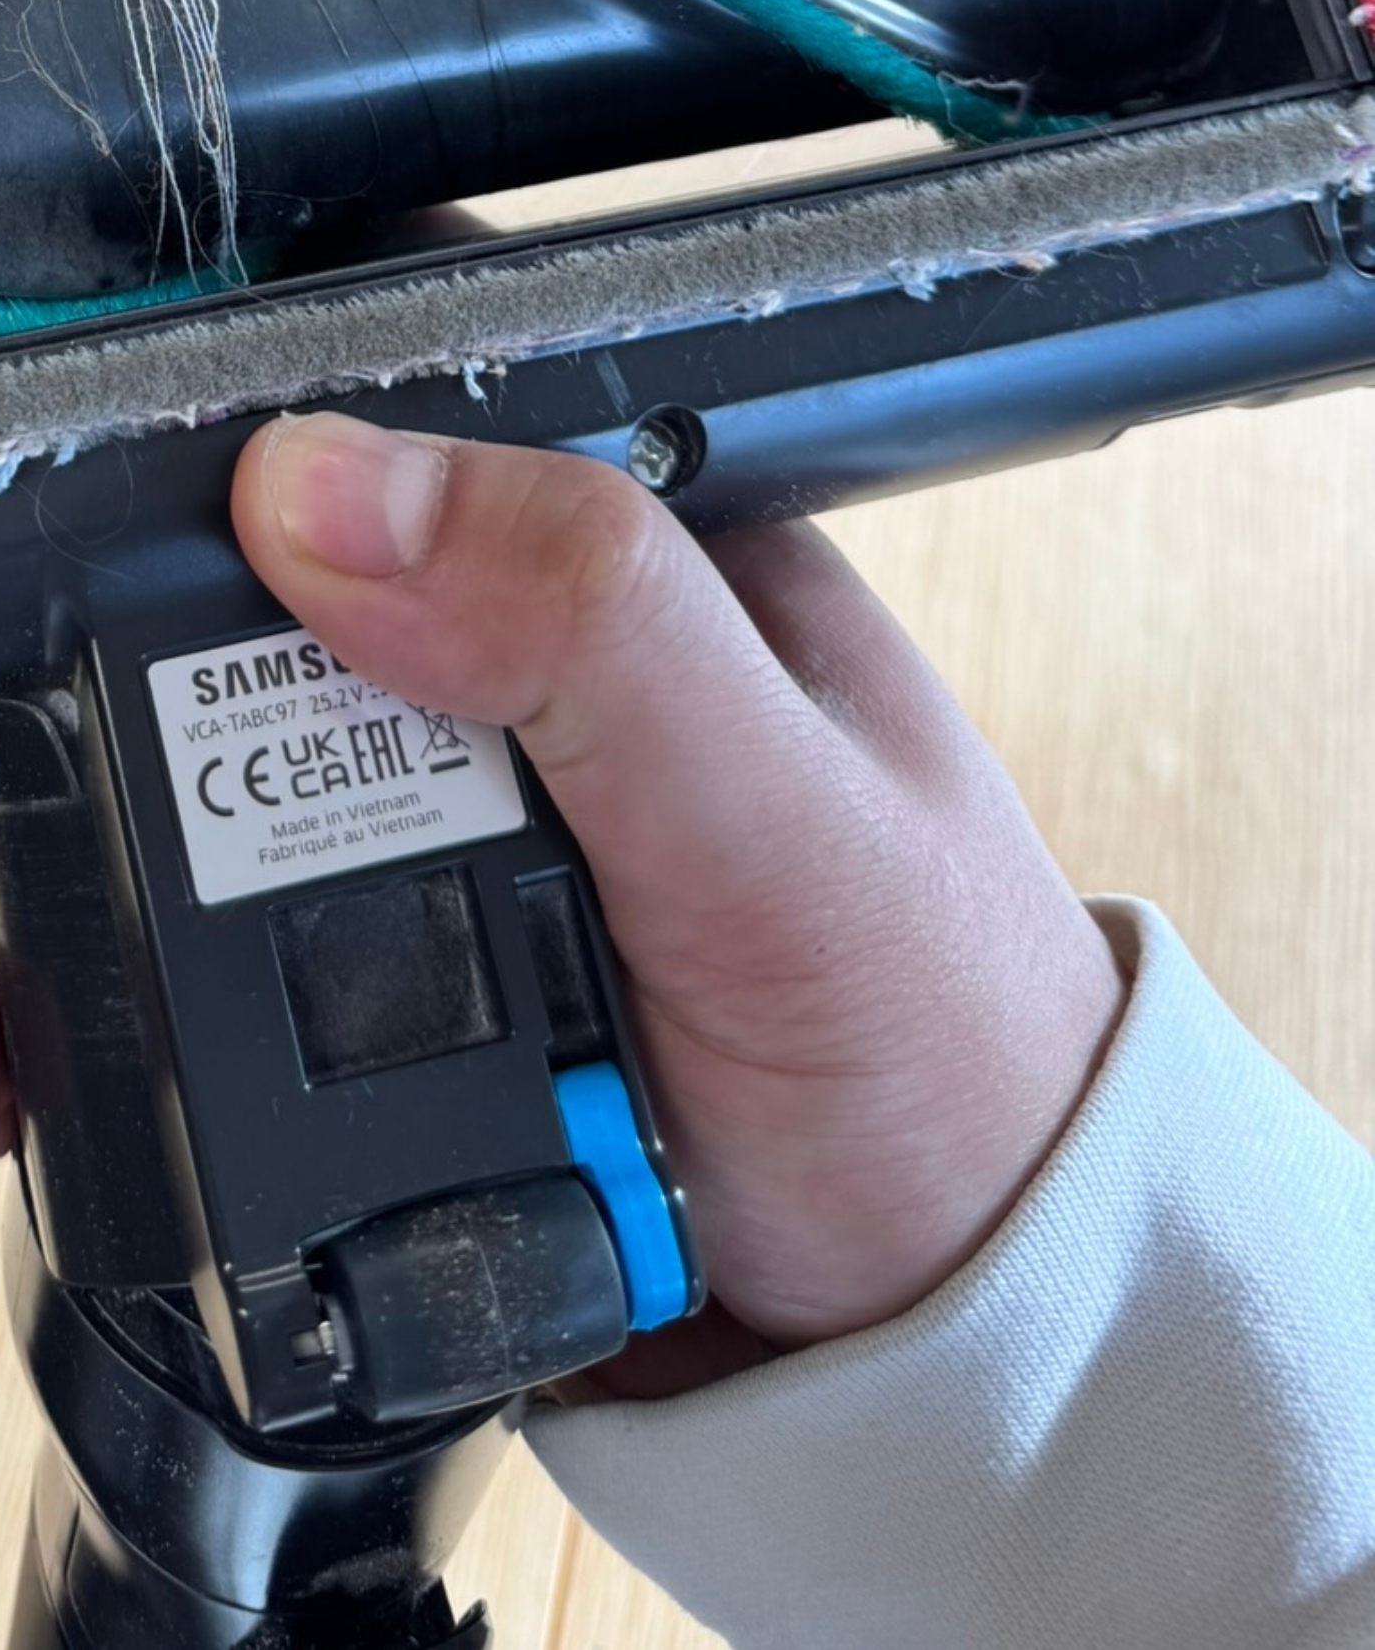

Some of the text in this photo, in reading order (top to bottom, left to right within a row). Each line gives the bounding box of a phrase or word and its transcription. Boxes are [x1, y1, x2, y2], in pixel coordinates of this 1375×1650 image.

[191, 642, 351, 706] SAMS
[182, 700, 298, 743] VCA-TABC97
[257, 808, 444, 867] Fabriqué au Vietnam
[270, 790, 422, 841] Made in Vietnam
